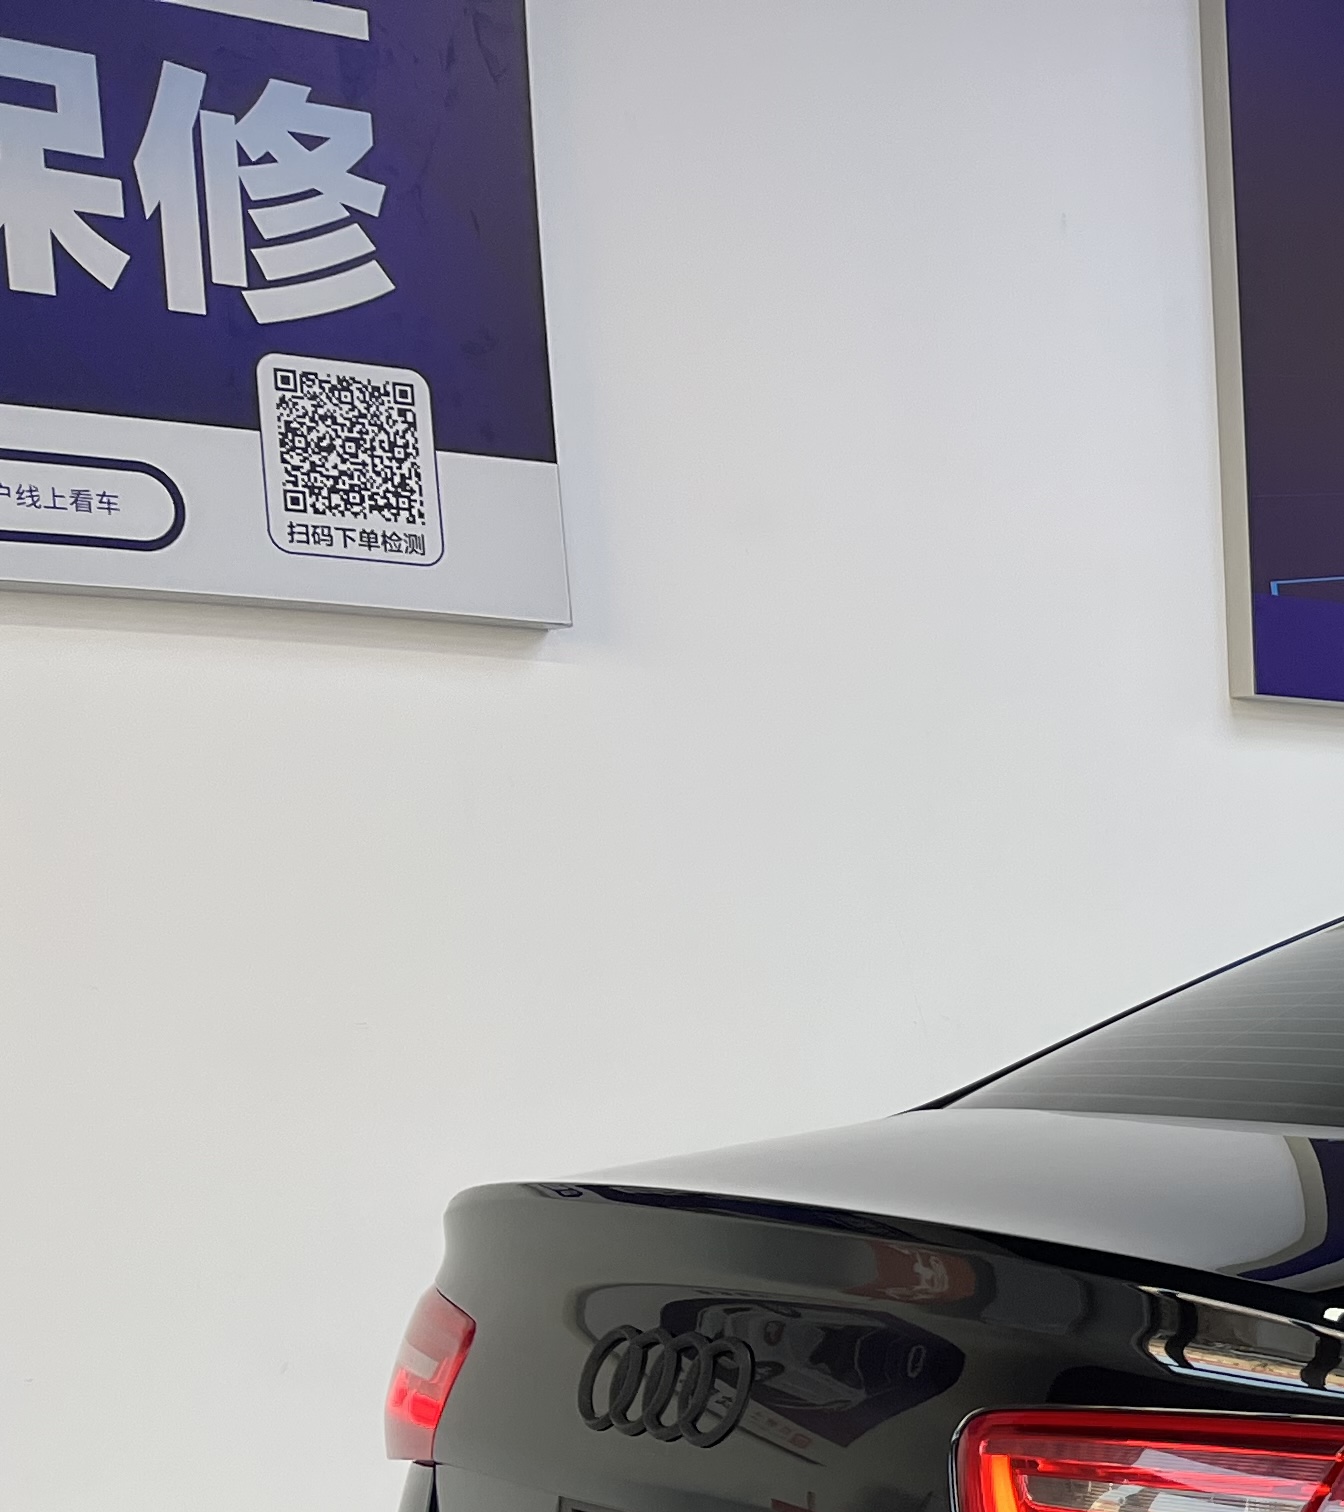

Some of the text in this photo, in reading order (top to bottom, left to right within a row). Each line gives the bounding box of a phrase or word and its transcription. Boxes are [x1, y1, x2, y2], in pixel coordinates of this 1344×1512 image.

[287, 522, 425, 557] 扫码下单检测
